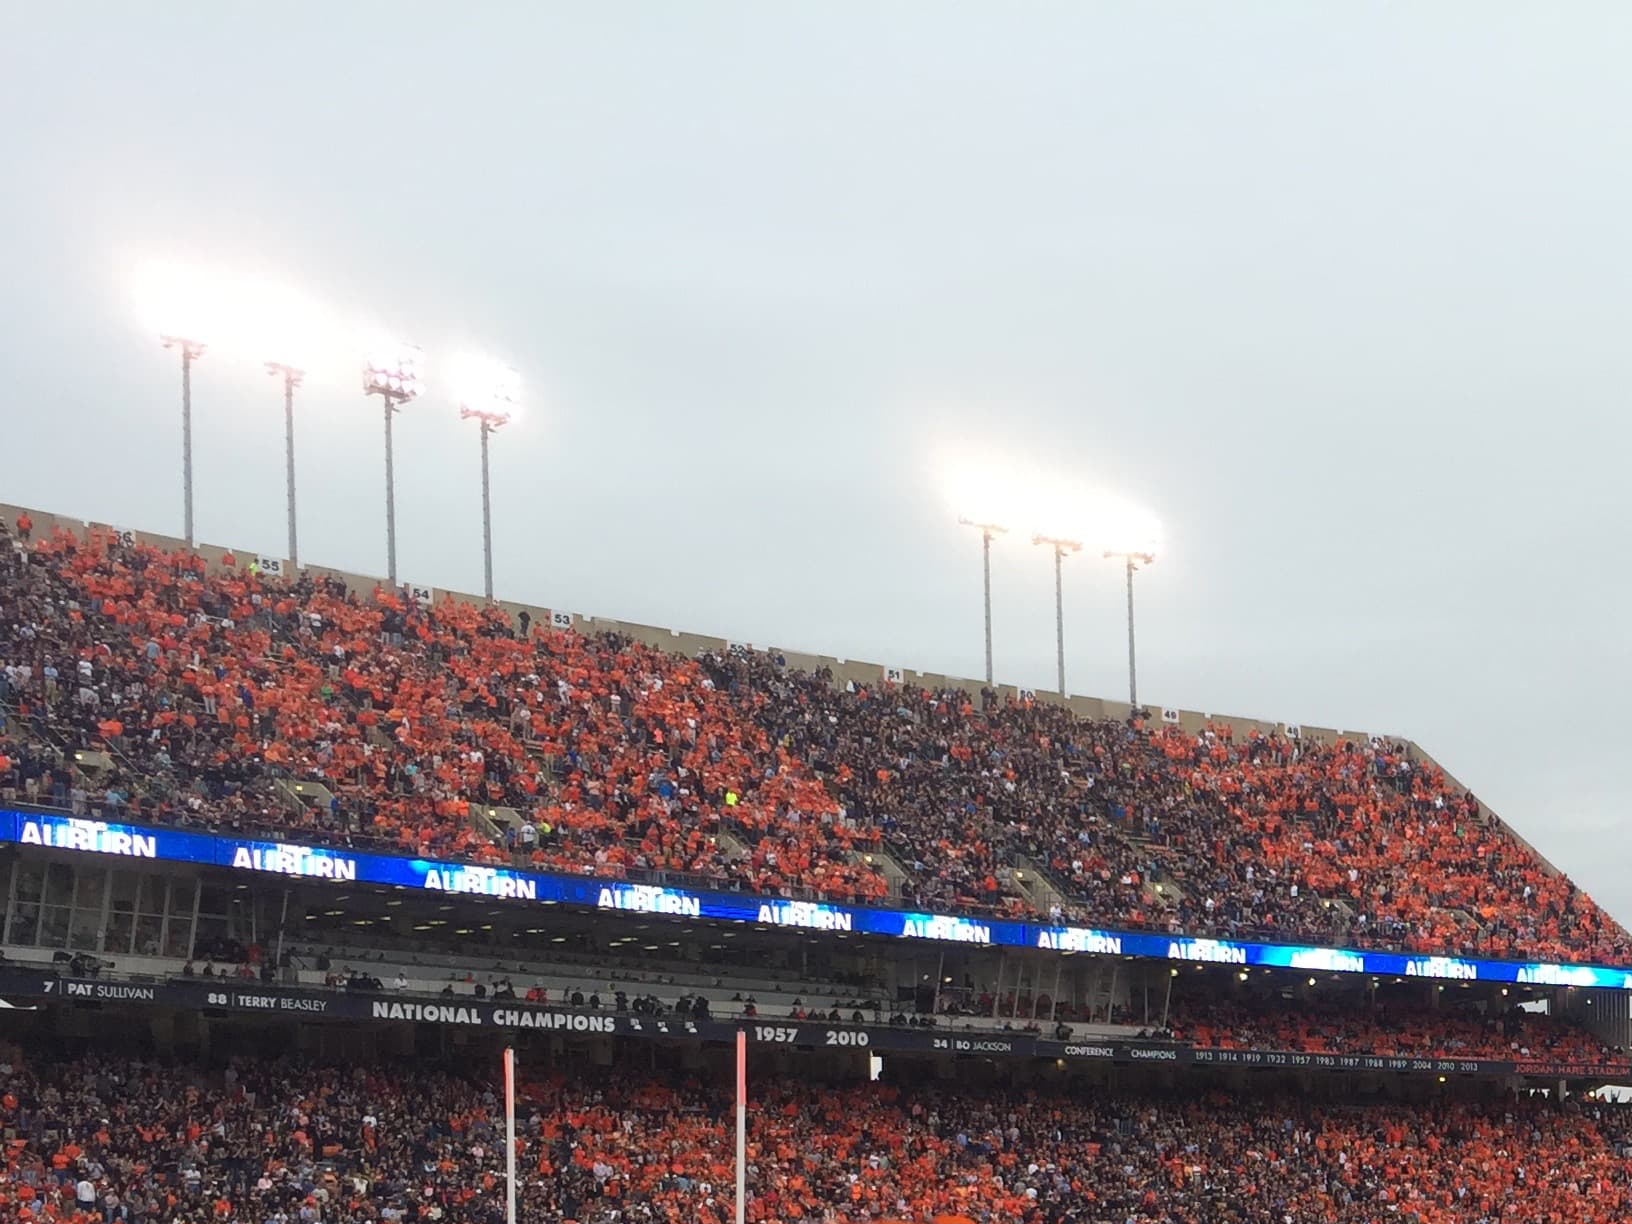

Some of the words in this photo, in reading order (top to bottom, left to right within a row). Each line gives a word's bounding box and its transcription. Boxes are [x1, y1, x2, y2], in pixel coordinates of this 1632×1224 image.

[262, 559, 279, 571] 55
[413, 588, 429, 599] 54
[554, 613, 570, 625] 53
[888, 669, 899, 679] 51
[43, 981, 55, 993] 7
[67, 982, 94, 996] PAT
[96, 984, 154, 999] SULLIVAN
[207, 992, 228, 1005] 88
[238, 994, 278, 1008] TERRY
[280, 998, 328, 1012] BEASLEY
[372, 1001, 482, 1025] NATIONAL
[492, 1009, 616, 1032] CHAMPIONS
[754, 1026, 799, 1043] 1957
[825, 1031, 869, 1047] 2010
[933, 1039, 948, 1049] 34
[956, 1040, 970, 1050] BO
[972, 1041, 1012, 1052] JACKSON
[1064, 1045, 1114, 1057] CONFERENCE
[1130, 1048, 1176, 1060] CHAMPIONS
[1218, 1052, 1238, 1062] 1914
[1291, 1055, 1311, 1065] 1957
[1316, 1056, 1335, 1066] 1983
[1340, 1057, 1360, 1067] 1987
[1413, 1060, 1432, 1070] 2004
[1437, 1061, 1455, 1071] 2010
[1460, 1062, 1478, 1071] 2013
[1587, 1066, 1631, 1076] STADIUM
